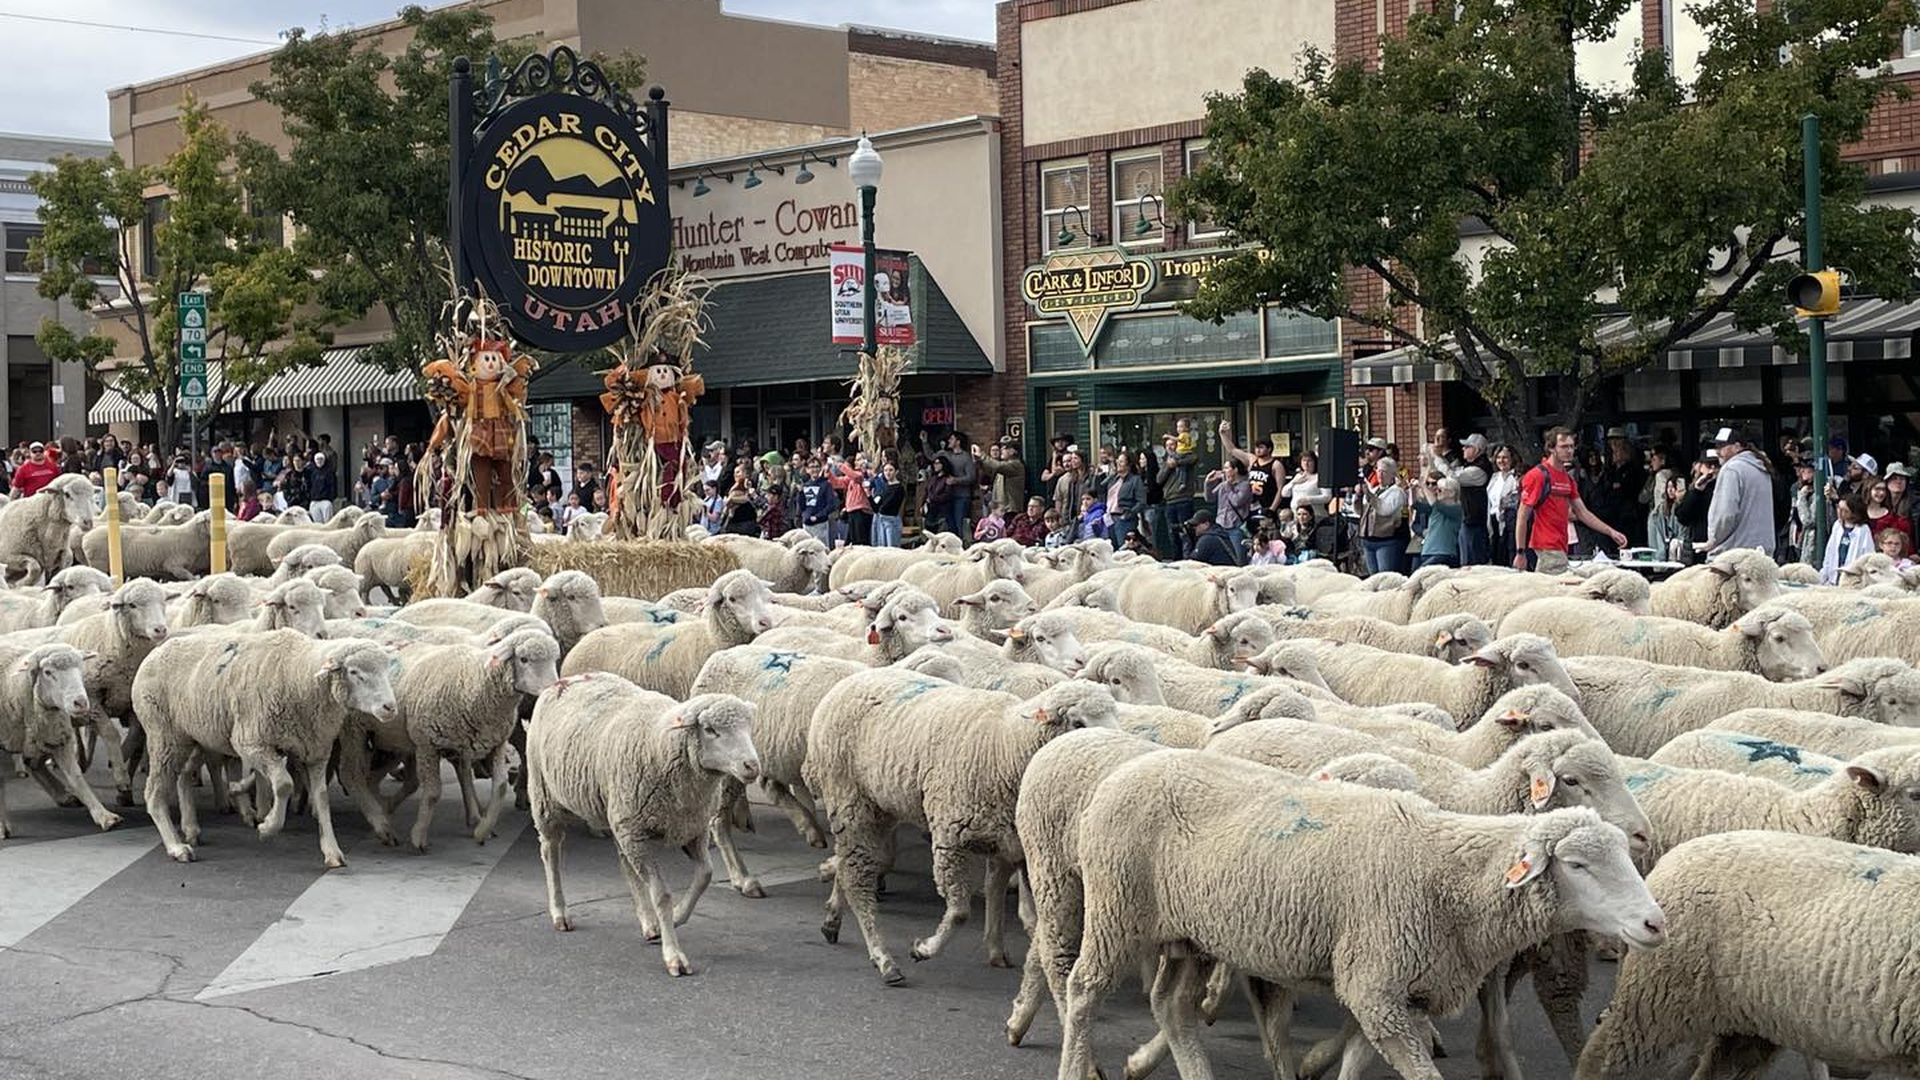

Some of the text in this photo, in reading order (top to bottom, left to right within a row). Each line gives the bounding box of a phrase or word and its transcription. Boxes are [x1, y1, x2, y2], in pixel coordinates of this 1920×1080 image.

[485, 113, 656, 206] CEDAR CITY
[671, 210, 744, 250] Hunter
[775, 199, 859, 236] Cowan
[513, 238, 592, 264] HISTORIC
[682, 248, 735, 273] Mountain
[528, 264, 616, 290] DOWNTOWN
[1025, 262, 1150, 299] CLARK & LINFORD
[523, 294, 625, 333] UTAH
[187, 330, 201, 340] 70
[185, 364, 203, 373] END
[188, 398, 202, 408] 79
[923, 408, 952, 424] OPEN
[1248, 470, 1269, 482] PHX
